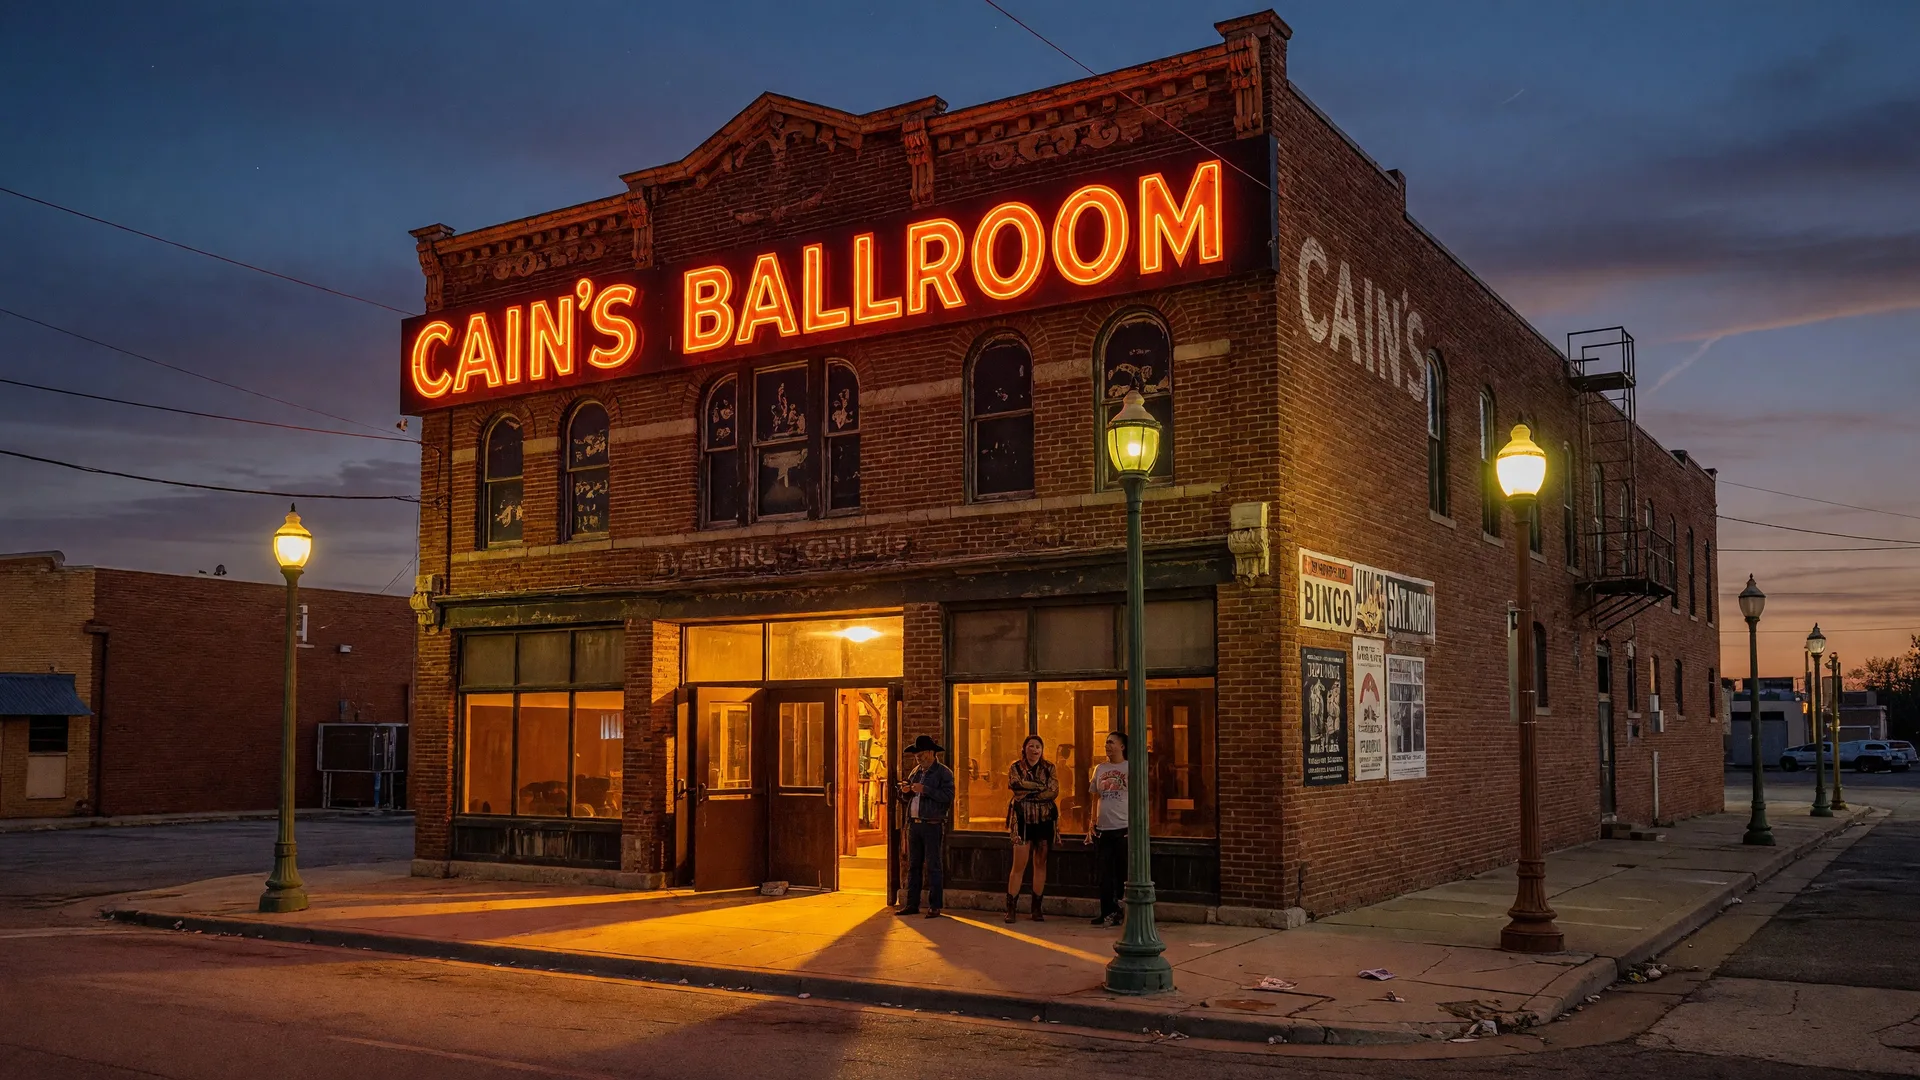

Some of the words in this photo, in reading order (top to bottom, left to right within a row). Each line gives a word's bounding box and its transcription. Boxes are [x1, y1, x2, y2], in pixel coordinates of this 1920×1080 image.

[411, 278, 638, 400] CAIN'S
[683, 159, 1224, 355] BALLROOM
[1298, 236, 1426, 402] CAIN'S
[1304, 580, 1352, 628] BINGO
[1409, 591, 1431, 633] NIGHT
